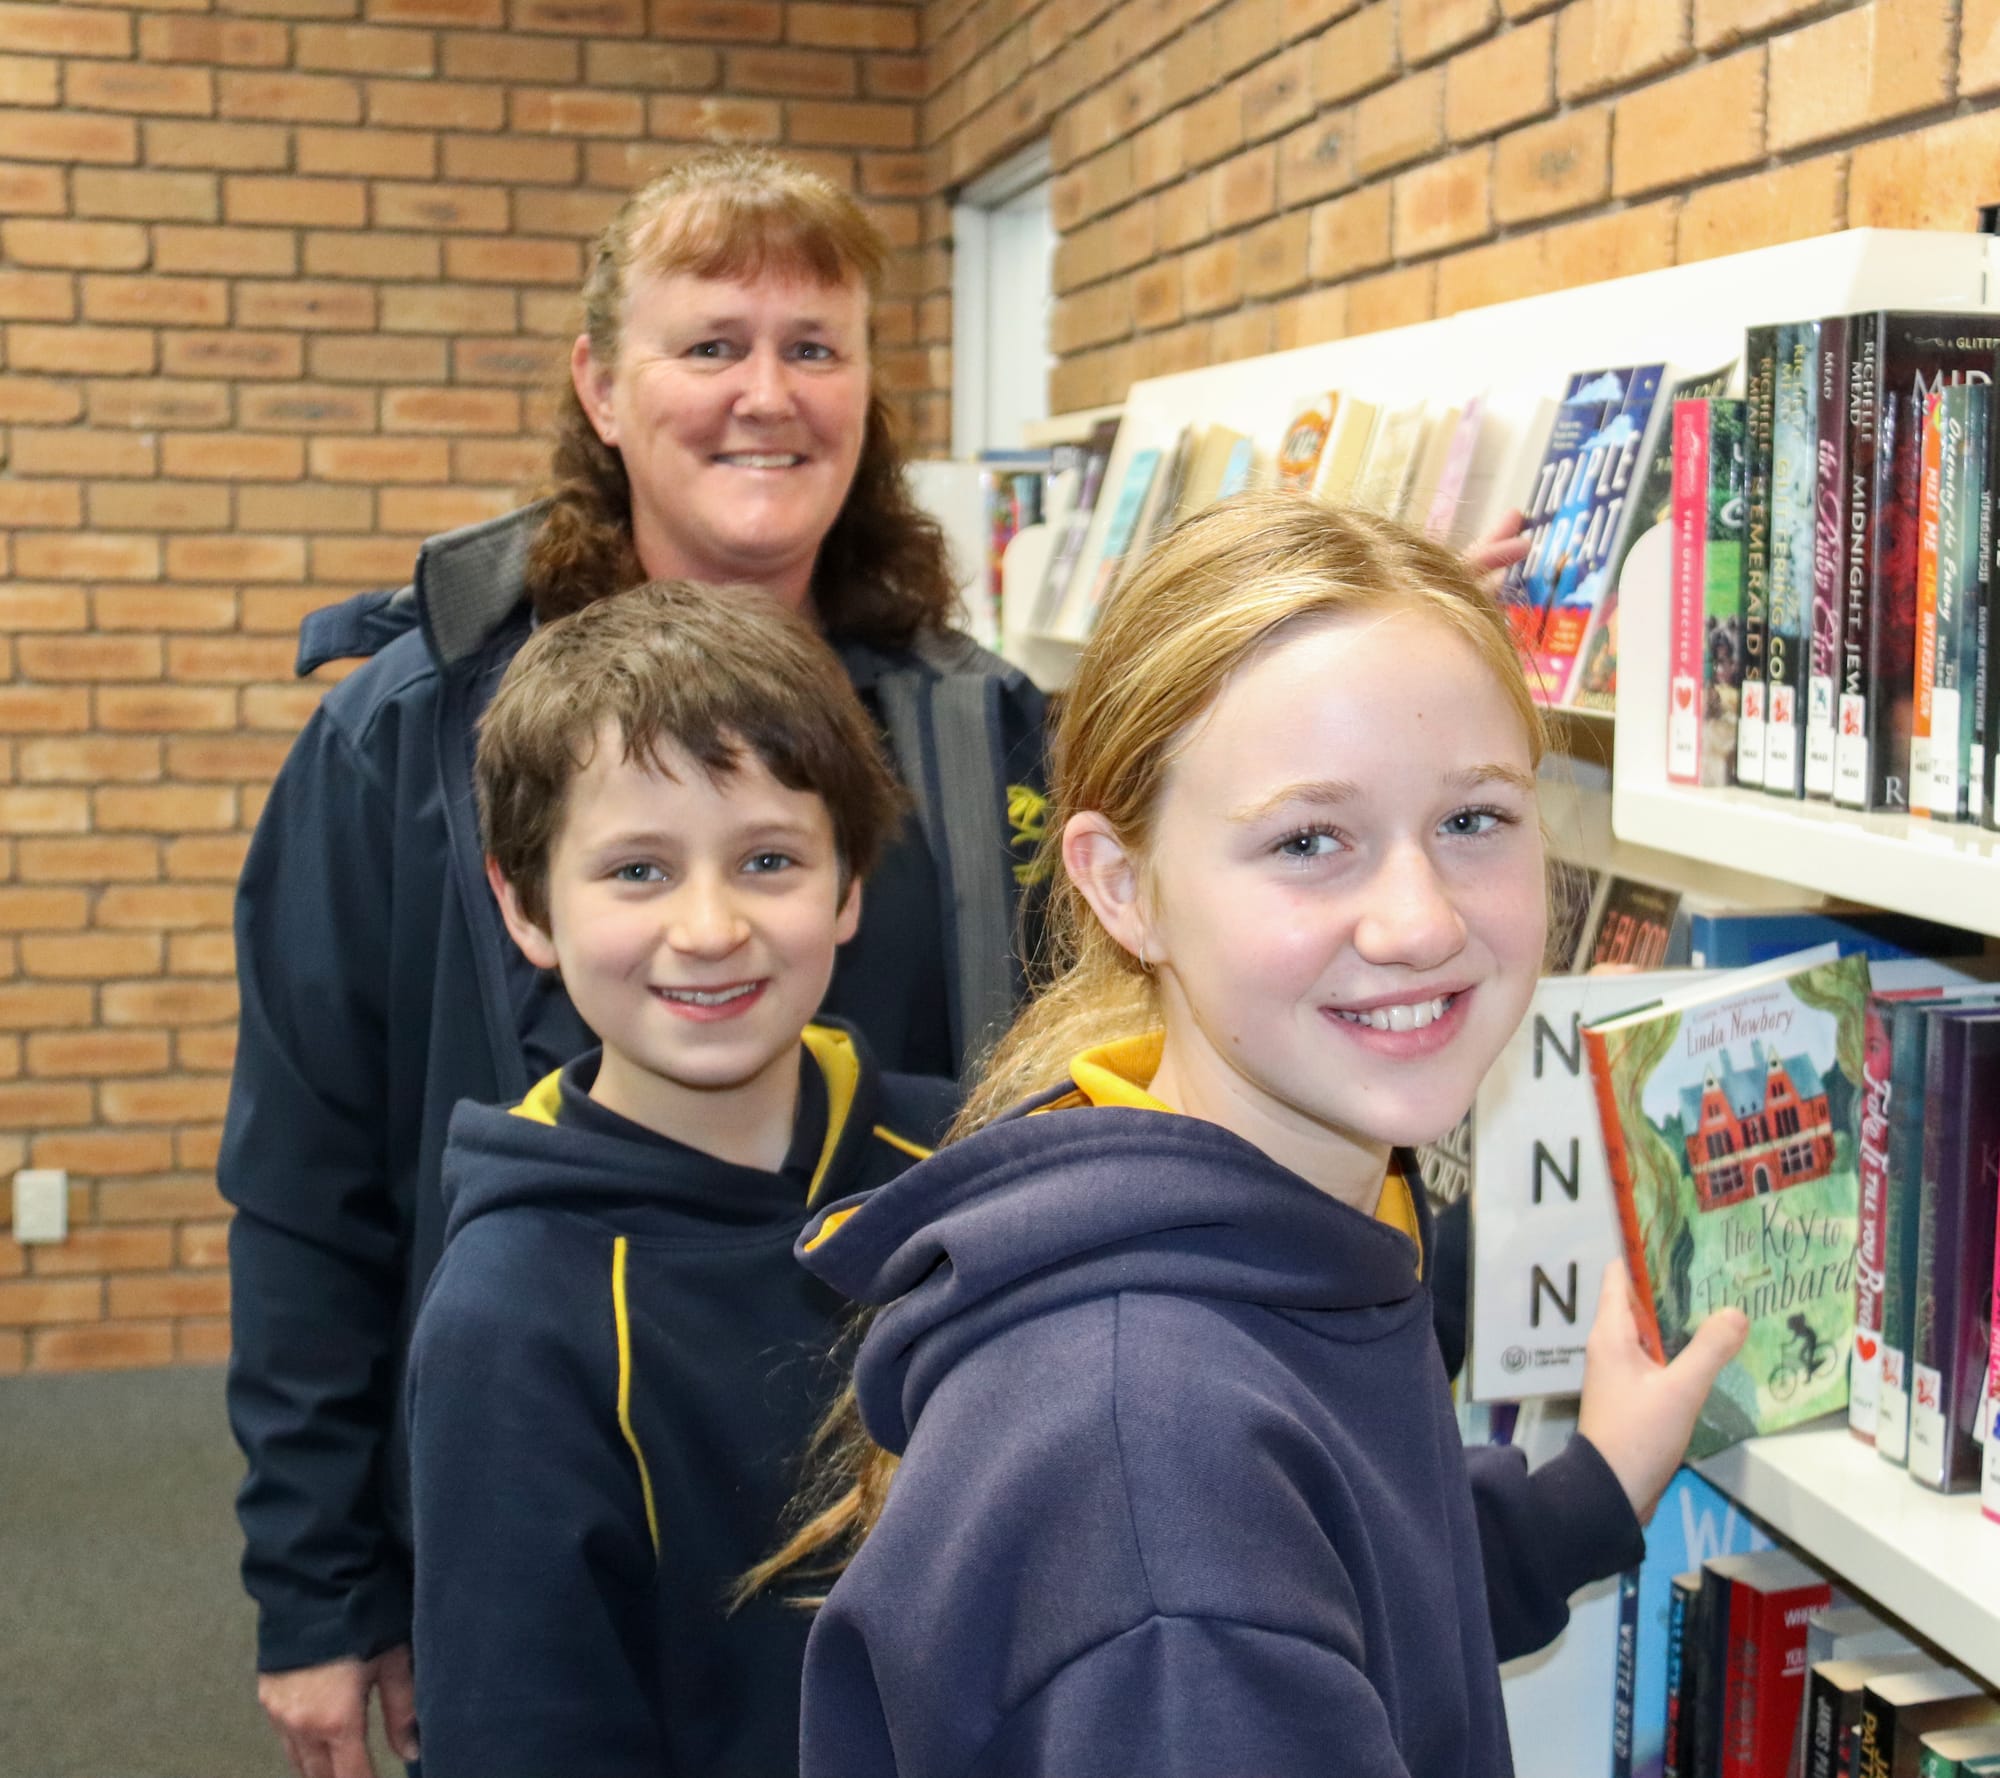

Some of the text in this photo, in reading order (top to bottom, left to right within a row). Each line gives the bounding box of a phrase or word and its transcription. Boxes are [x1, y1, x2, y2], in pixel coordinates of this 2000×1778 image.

[1748, 376, 1761, 437] MEAD
[1758, 357, 1774, 450] RICHELLE
[1791, 343, 1807, 437] RICHELLE
[1823, 351, 1835, 400] MEAD
[1850, 361, 1863, 426] MEAD
[1861, 341, 1875, 442] RICHELLE
[1531, 430, 1641, 519] TRIPLE
[1818, 439, 1838, 480] the
[1926, 467, 1939, 513] MEET
[1814, 483, 1842, 591] Ruby
[1848, 474, 1867, 631] MIDNIGHT
[1923, 519, 1938, 553] ME
[1746, 504, 1765, 656] EMERALD
[1769, 457, 1791, 687] GLITTERING CO
[1937, 556, 1957, 621] Enemy
[1977, 605, 1988, 643] DAVID
[1919, 611, 1937, 720] INTERSECTION
[1533, 1011, 1581, 1079] N
[1686, 1021, 1725, 1057] Linda
[1730, 1006, 1795, 1041] Newbery
[1861, 1061, 1892, 1139] Fake
[1532, 1137, 1579, 1205] N
[1720, 1198, 1842, 1265] The Key to
[1529, 1261, 1577, 1329] N
[1815, 1696, 1832, 1751] JAMES
